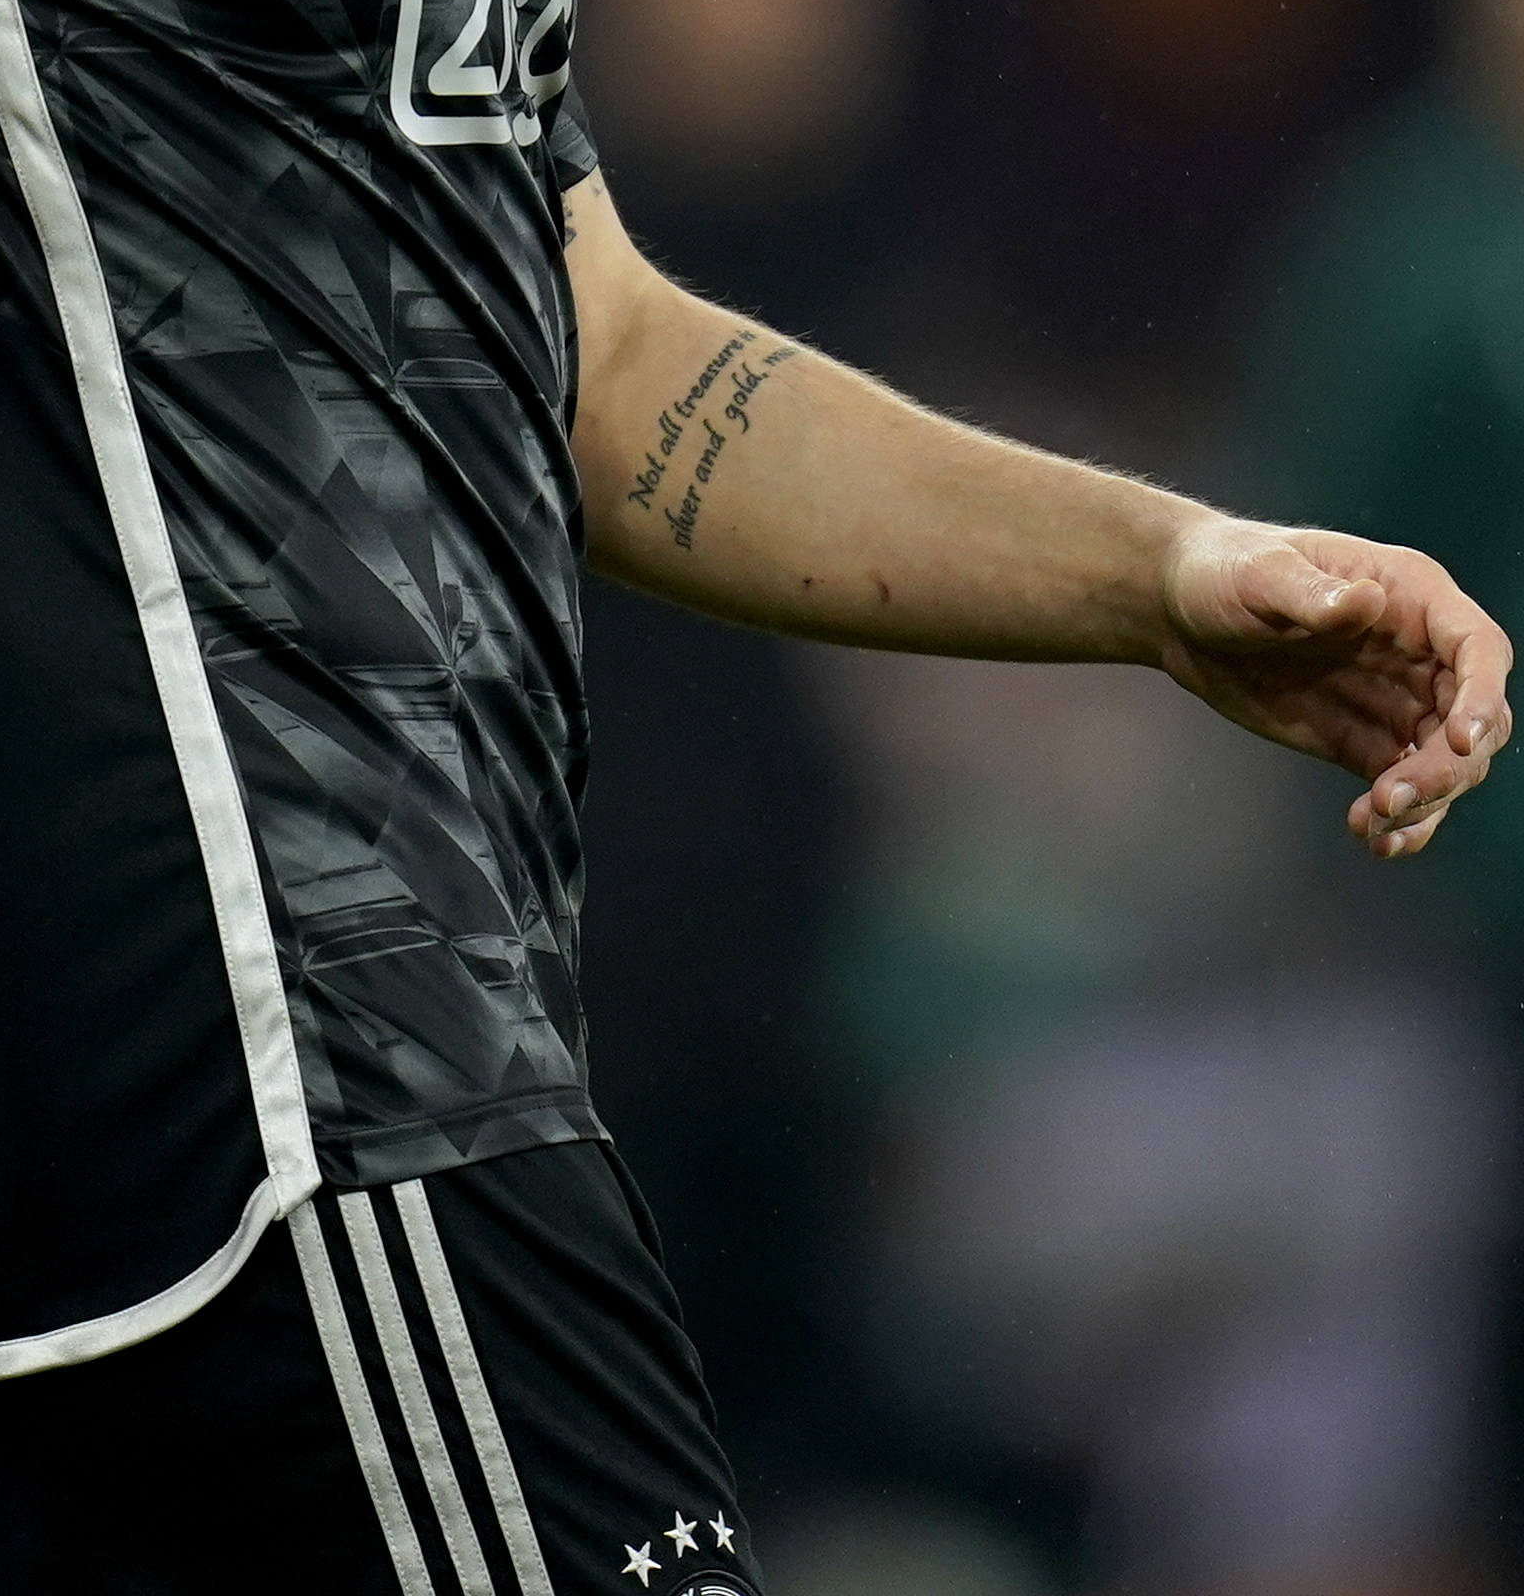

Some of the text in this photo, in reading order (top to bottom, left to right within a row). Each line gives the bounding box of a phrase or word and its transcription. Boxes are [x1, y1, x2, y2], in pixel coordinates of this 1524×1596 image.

[628, 452, 667, 510] Not
[658, 410, 684, 456] all
[674, 338, 744, 419] treasure
[664, 483, 703, 551] silver
[696, 418, 727, 484] and
